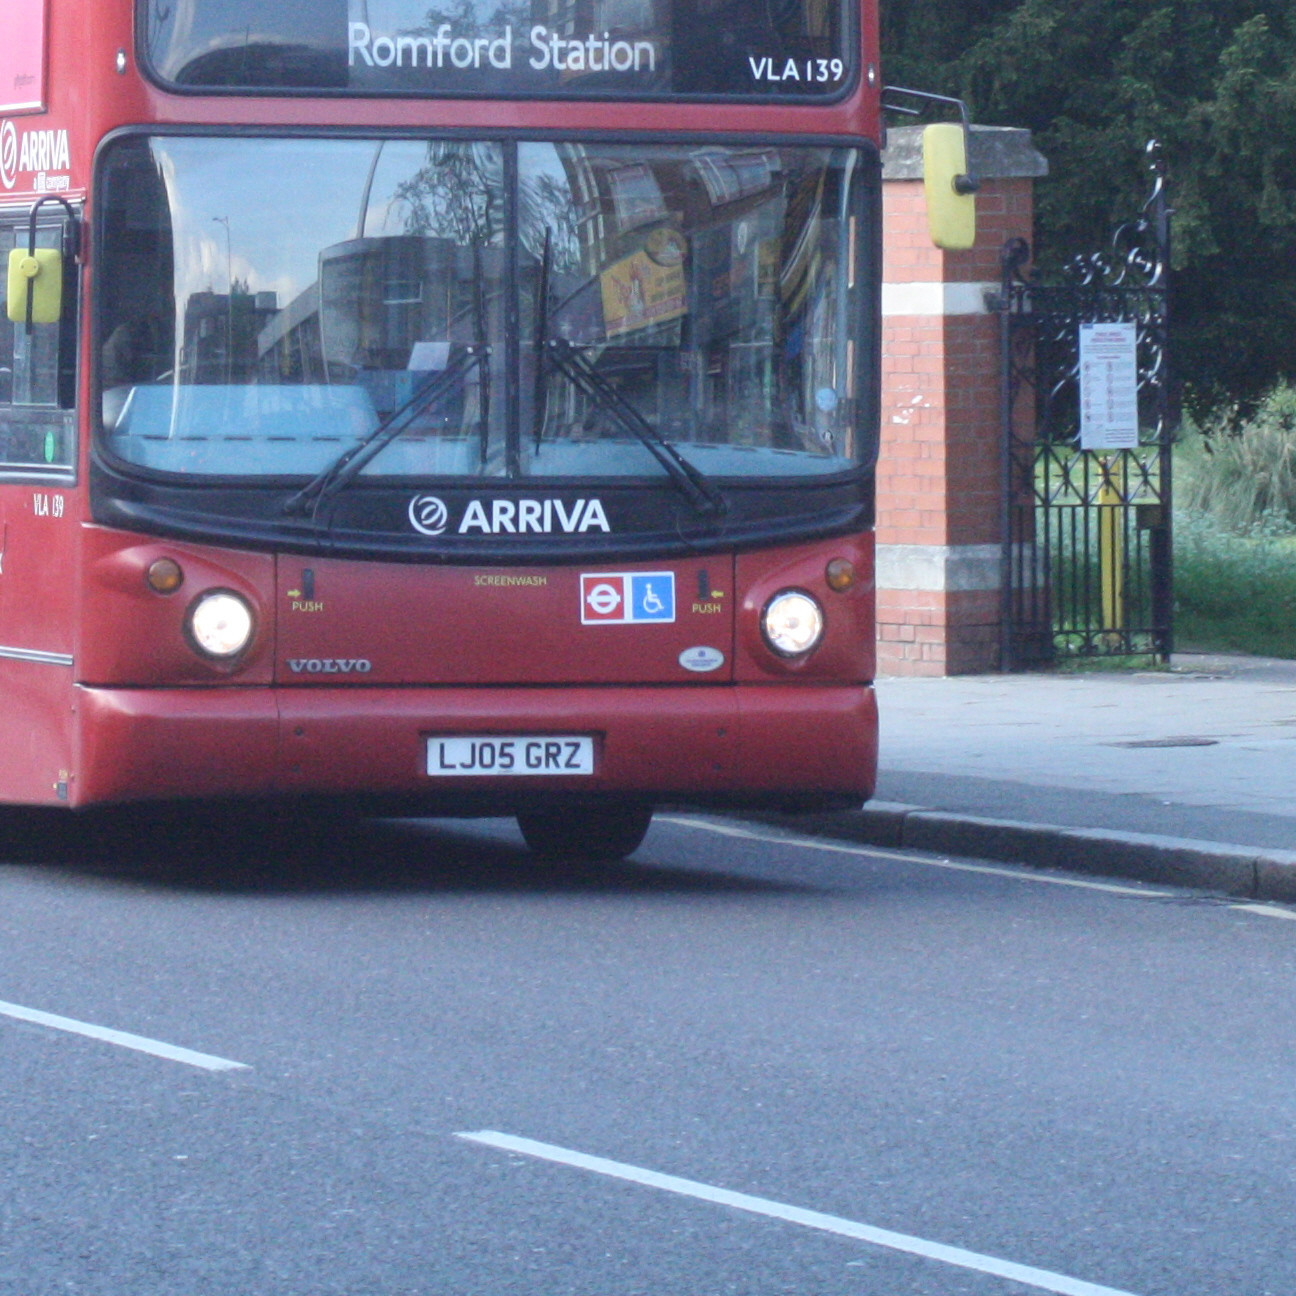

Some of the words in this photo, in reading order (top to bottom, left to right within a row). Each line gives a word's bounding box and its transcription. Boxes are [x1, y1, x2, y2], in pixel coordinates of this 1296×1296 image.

[348, 21, 512, 69] Romford
[529, 25, 655, 72] Station
[748, 57, 800, 80] VLA
[807, 58, 843, 82] 139
[18, 129, 70, 172] ARRIVA
[33, 493, 49, 516] VLA
[52, 494, 64, 517] 139
[458, 499, 611, 534] ARRIVA
[473, 576, 547, 587] SCREENWASH
[292, 601, 323, 612] PUSH
[692, 603, 721, 613] PUSH
[287, 659, 372, 673] VOLVO
[439, 742, 515, 769] LJ05
[525, 742, 581, 769] GRZ
